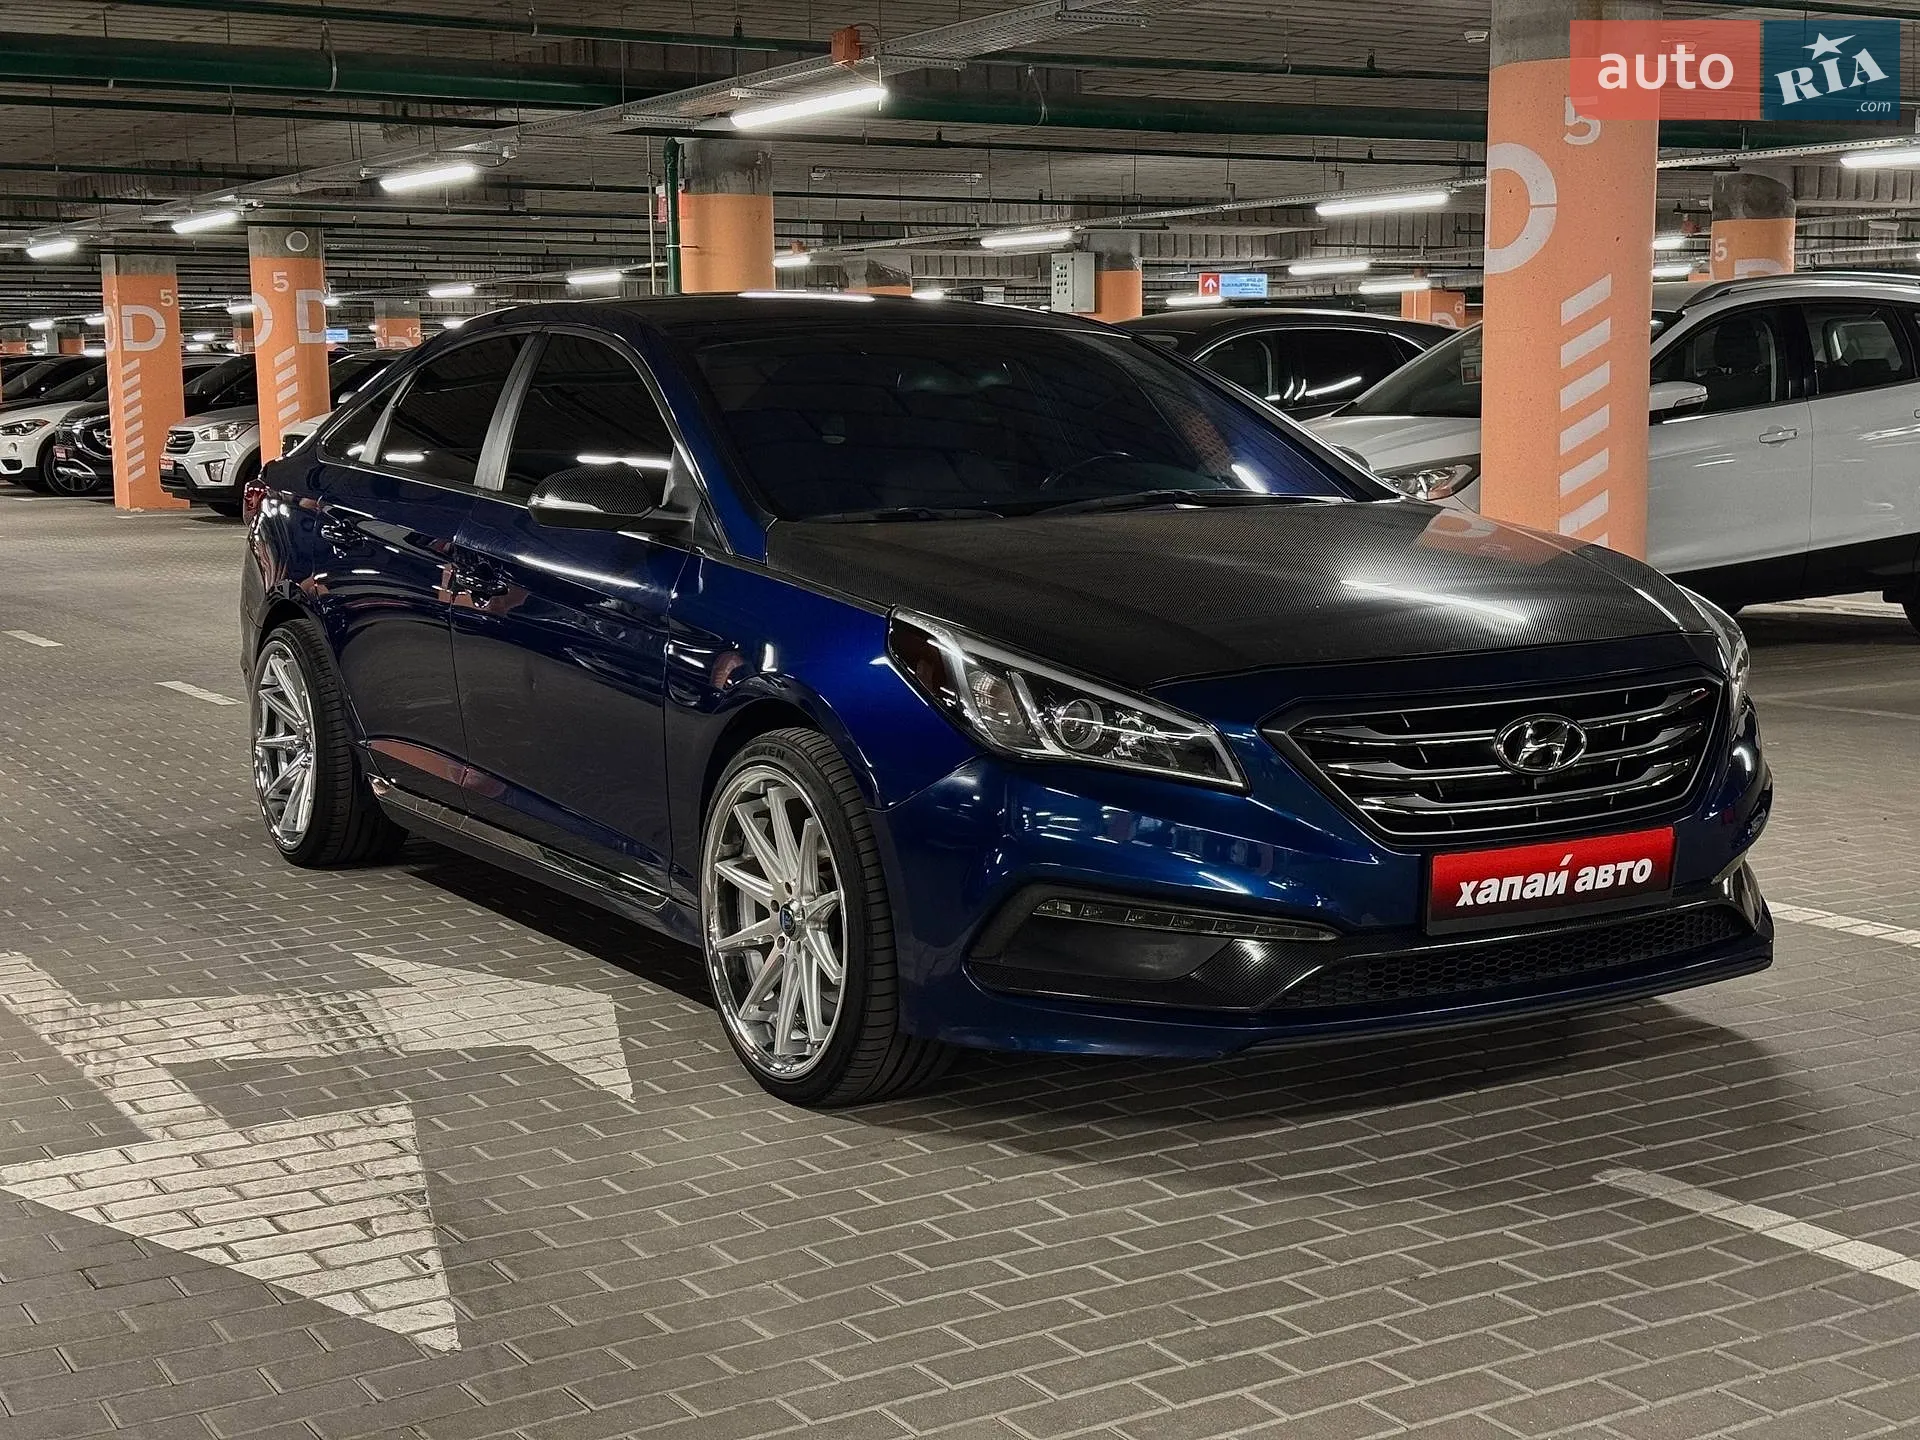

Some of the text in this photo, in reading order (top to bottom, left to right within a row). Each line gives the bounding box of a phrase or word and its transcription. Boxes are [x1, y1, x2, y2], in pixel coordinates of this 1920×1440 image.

[1563, 96, 1601, 145] 5
[1484, 142, 1557, 275] D
[1715, 239, 1728, 261] 5
[160, 289, 174, 307] 5
[272, 271, 289, 292] 5
[121, 305, 166, 352] D
[1574, 858, 1653, 892] авто
